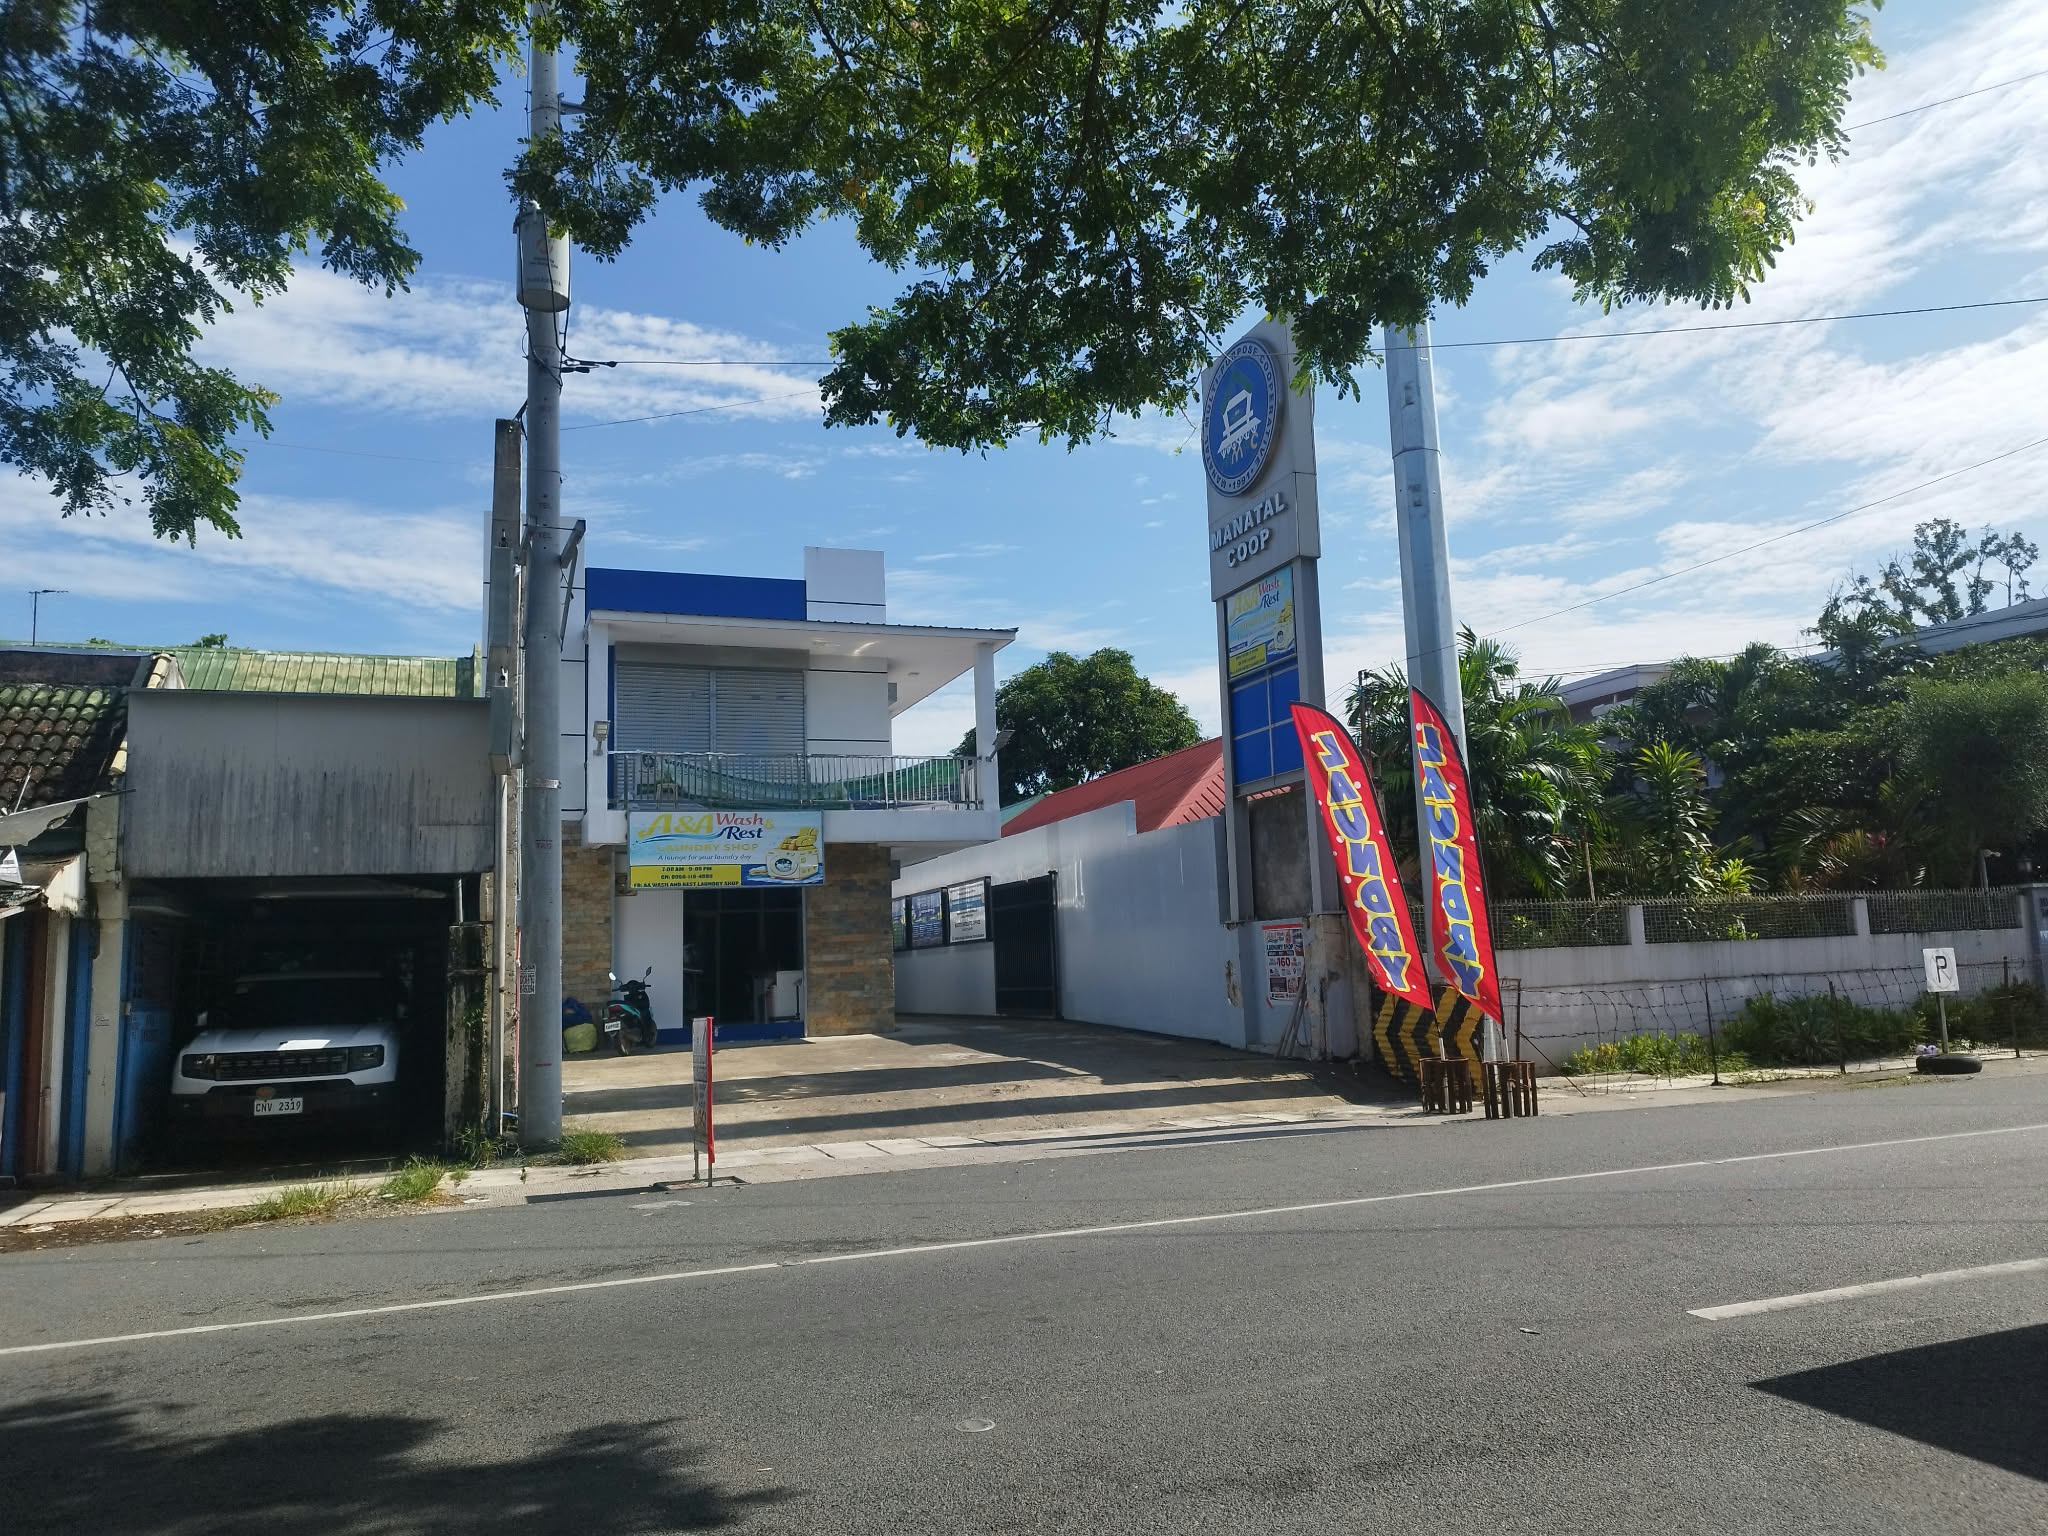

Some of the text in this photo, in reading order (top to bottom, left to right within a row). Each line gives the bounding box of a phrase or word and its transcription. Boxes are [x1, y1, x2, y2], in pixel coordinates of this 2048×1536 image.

[1255, 354, 1275, 467] COOPERATIVE
[1233, 472, 1251, 489] 1991
[1211, 492, 1288, 552] MANATAL
[1227, 527, 1271, 569] COOP
[1258, 575, 1279, 596] Wash
[1260, 590, 1280, 609] Rest
[638, 813, 713, 838] A&A
[716, 812, 763, 826] Wash
[721, 826, 763, 841] Rest
[656, 843, 759, 854] LAUNDRY SHOP
[256, 1100, 301, 1113] CNV 2319
